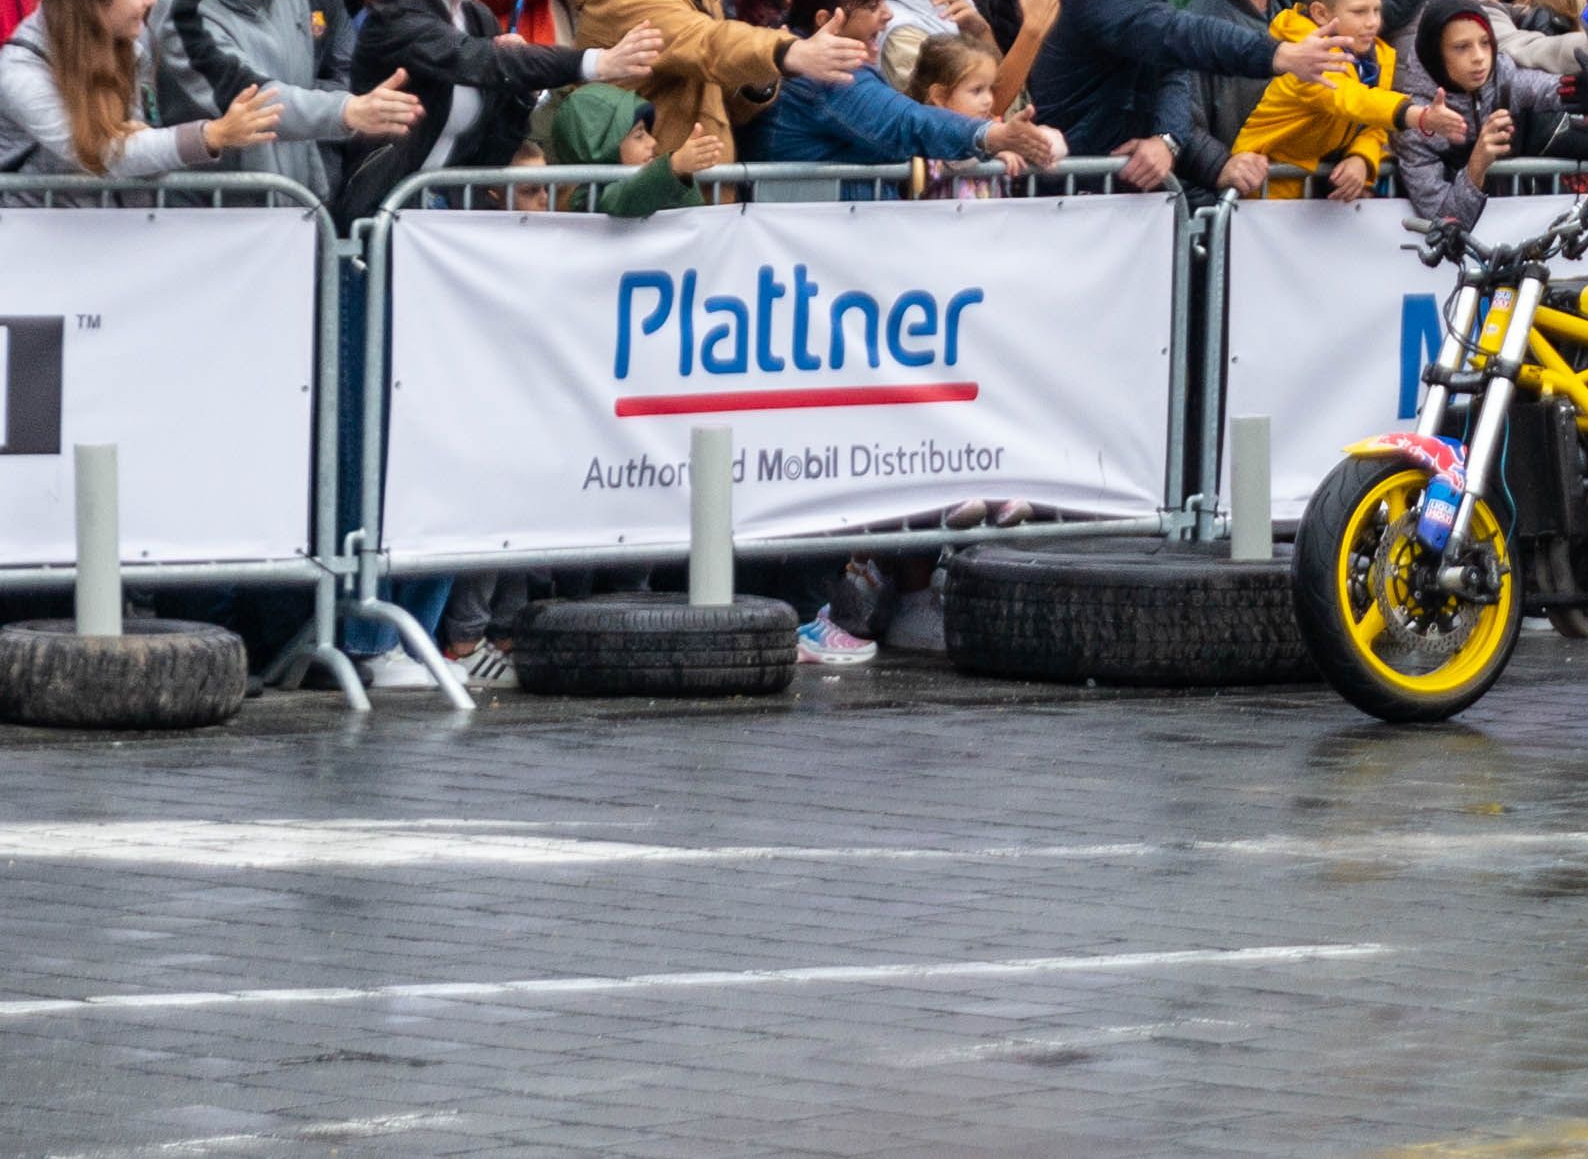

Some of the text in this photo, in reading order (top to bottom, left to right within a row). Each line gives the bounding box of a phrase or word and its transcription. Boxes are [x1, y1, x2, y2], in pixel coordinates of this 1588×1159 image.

[76, 314, 102, 329] TM
[614, 263, 984, 380] Plattner
[582, 439, 1005, 490] Authord Mobil Distributor
